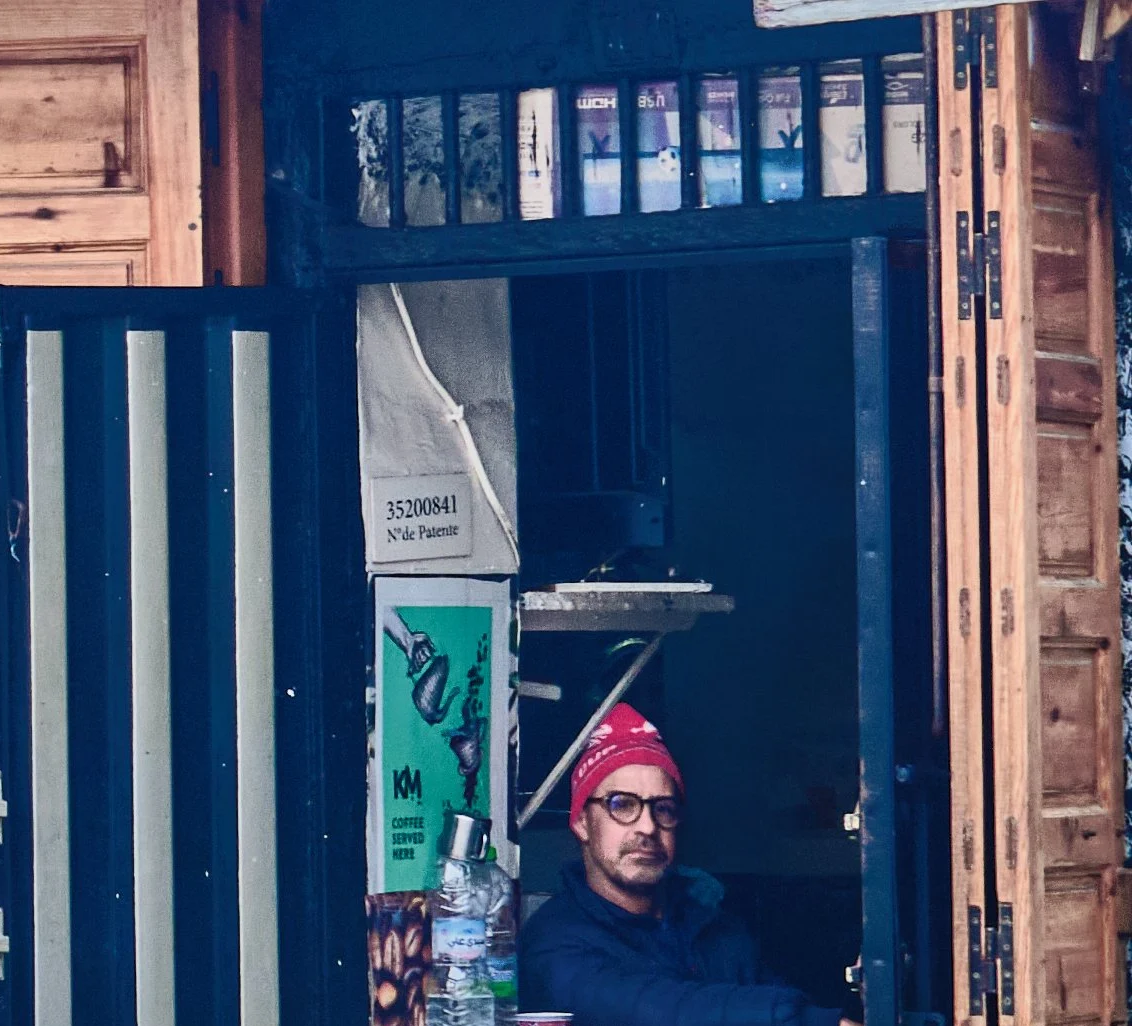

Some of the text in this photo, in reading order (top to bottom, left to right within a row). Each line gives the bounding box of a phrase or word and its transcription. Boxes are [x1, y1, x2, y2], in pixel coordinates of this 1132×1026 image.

[637, 92, 666, 108] USB
[386, 494, 456, 520] 35200841
[418, 525, 459, 541] Patente
[391, 816, 424, 829] COFFEE
[391, 831, 425, 845] SERVED
[391, 847, 415, 860] HERE
